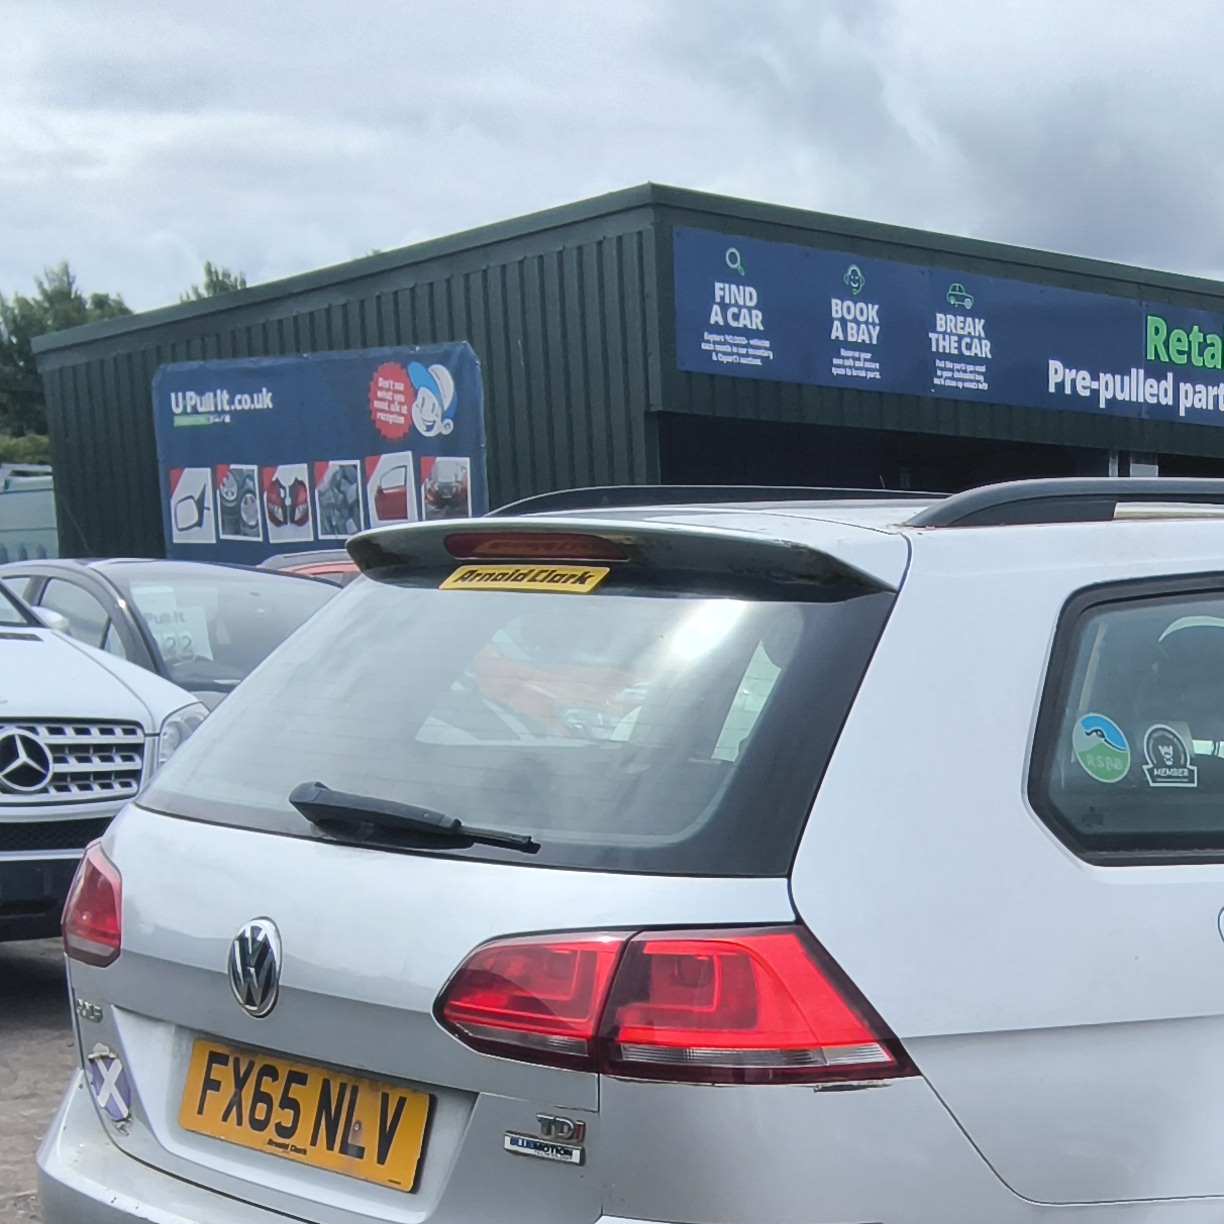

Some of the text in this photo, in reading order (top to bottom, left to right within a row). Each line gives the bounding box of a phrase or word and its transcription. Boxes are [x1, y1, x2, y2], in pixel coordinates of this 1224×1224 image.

[714, 281, 758, 307] FIND
[709, 304, 765, 331] A CAR
[831, 298, 879, 324] BOOK
[830, 320, 880, 345] A BAY
[936, 312, 985, 338] BREAK
[928, 332, 992, 359] THE CAR
[1048, 359, 1173, 409] Pre-pulled
[453, 569, 596, 585] Arnold Clark
[1153, 767, 1189, 777] MEMBER
[197, 1050, 408, 1166] FX65 NLV
[535, 1112, 585, 1141] TDI
